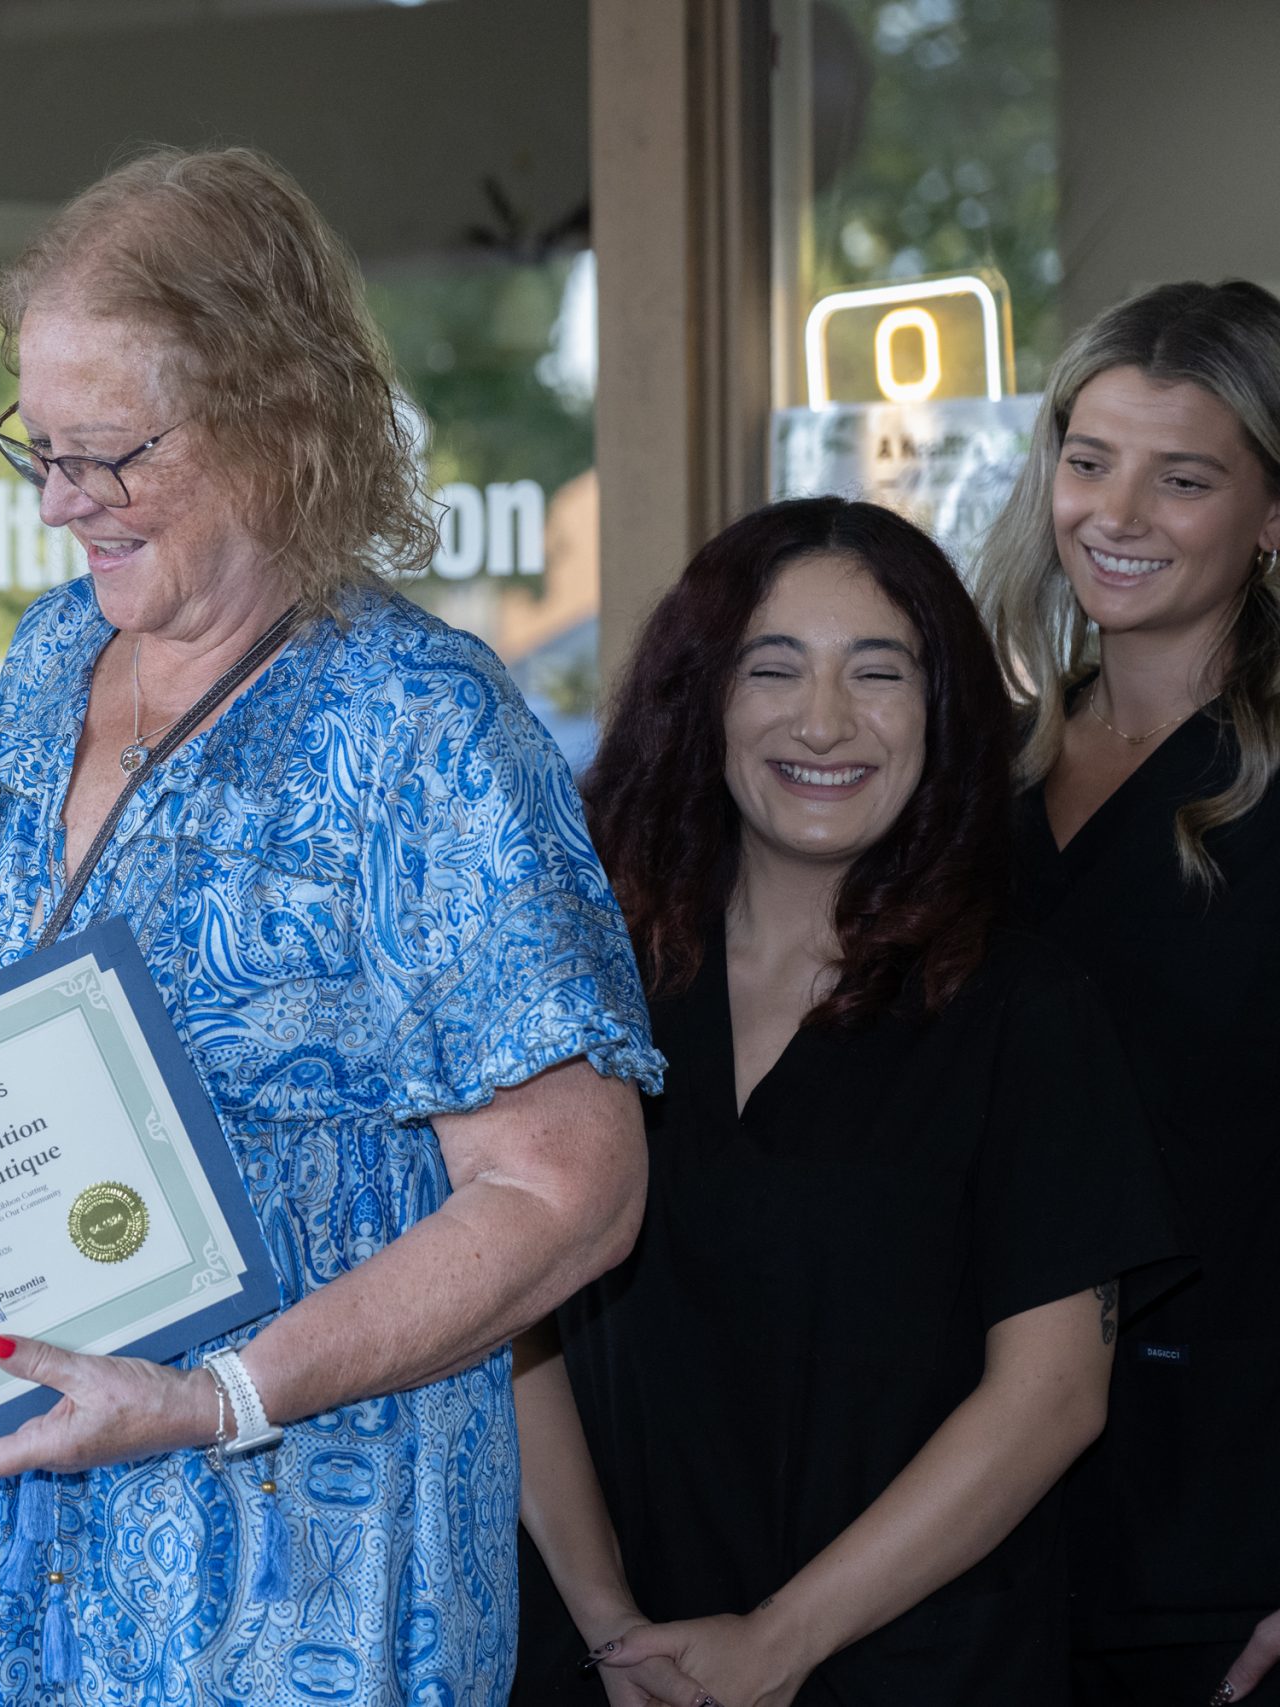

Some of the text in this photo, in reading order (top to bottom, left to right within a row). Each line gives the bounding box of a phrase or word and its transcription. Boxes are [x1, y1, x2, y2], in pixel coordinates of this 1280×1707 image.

[21, 1183, 49, 1200] Cutting
[5, 1207, 20, 1218] Our
[20, 1189, 62, 1211] Community
